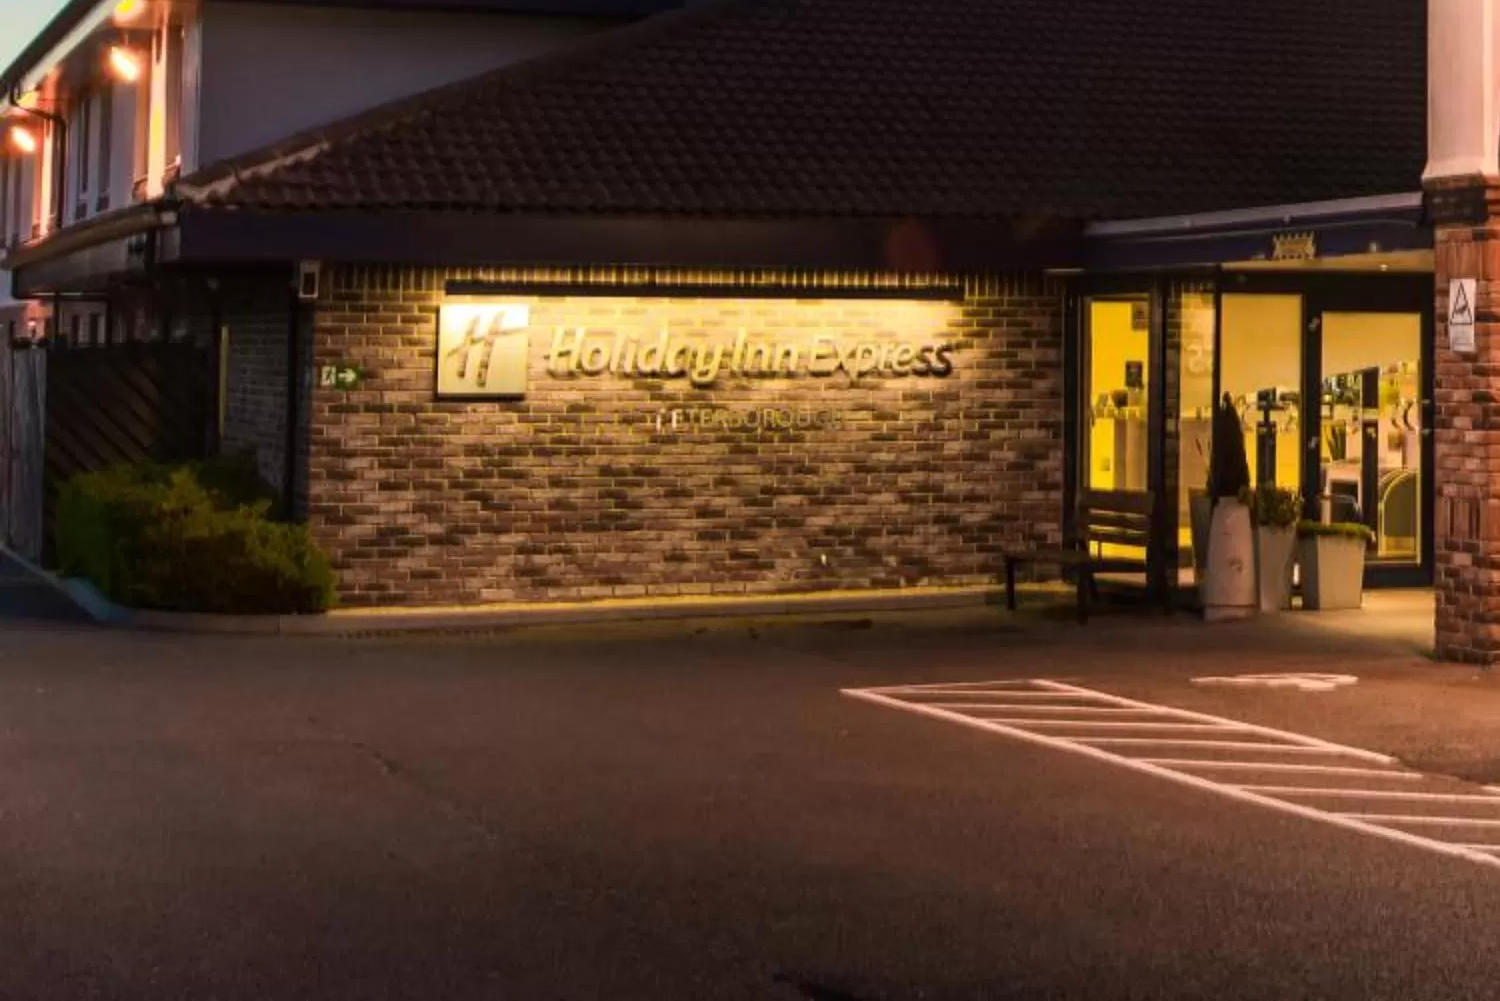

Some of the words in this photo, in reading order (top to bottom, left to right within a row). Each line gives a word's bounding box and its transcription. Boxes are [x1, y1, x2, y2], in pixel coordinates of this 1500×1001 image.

[545, 326, 723, 387] Holiday
[728, 328, 802, 377] Inn
[807, 334, 959, 385] Express
